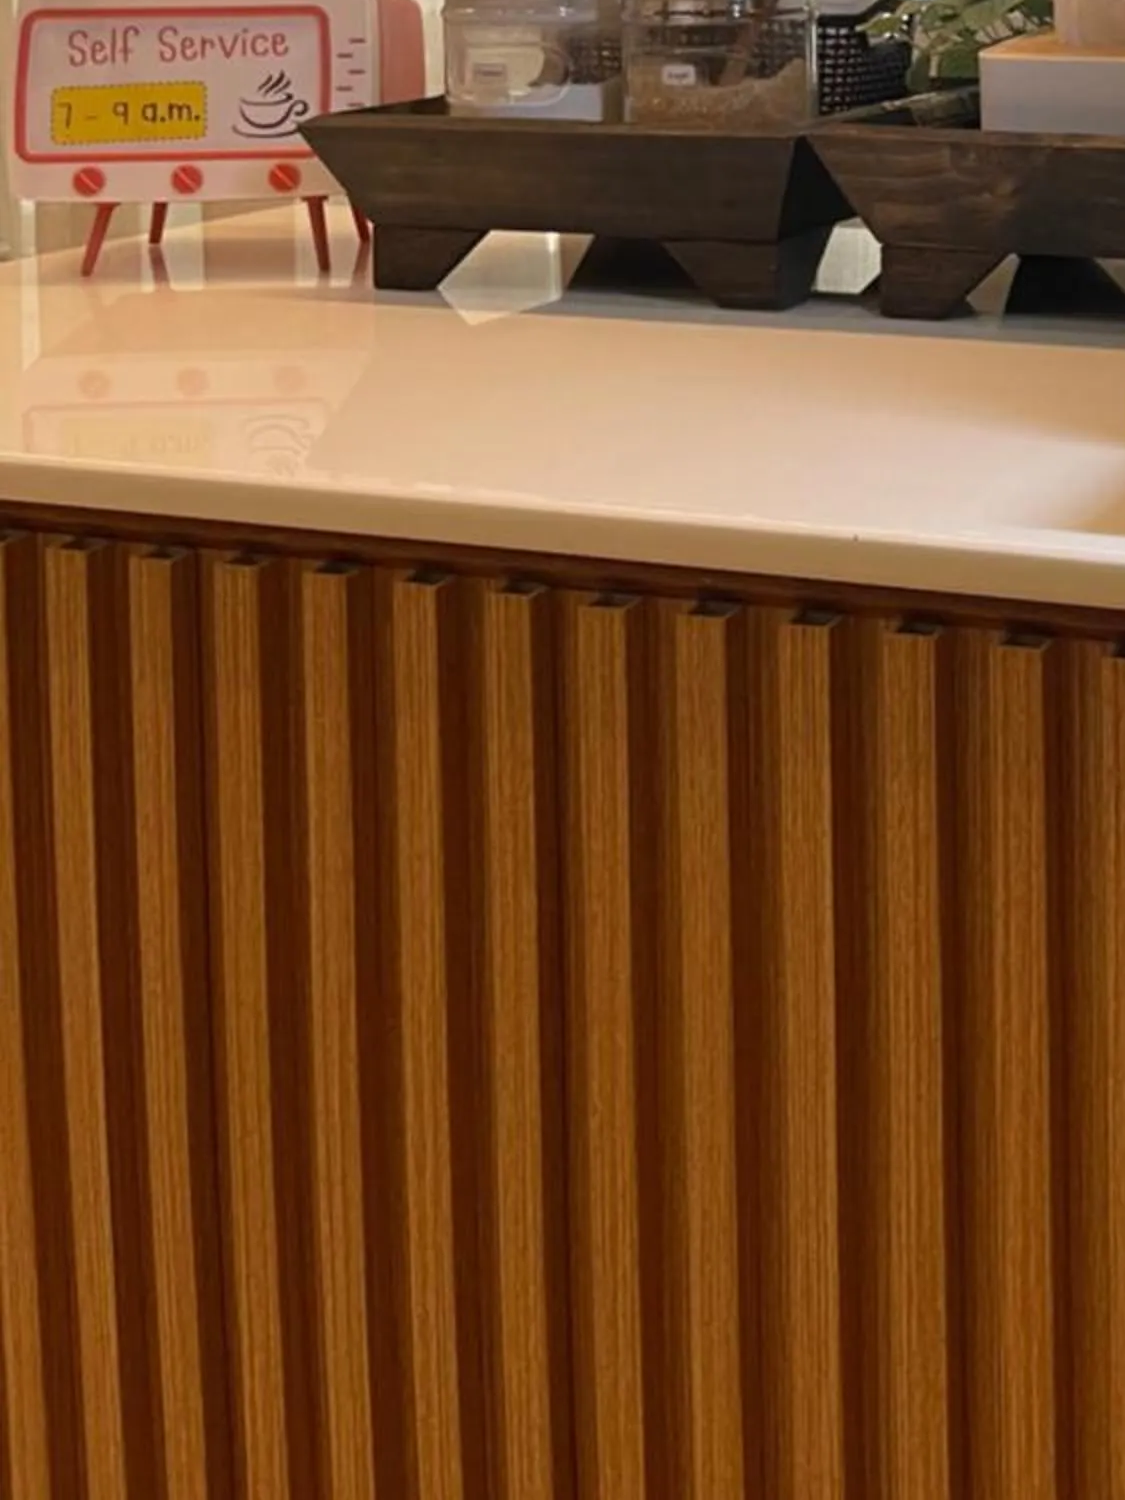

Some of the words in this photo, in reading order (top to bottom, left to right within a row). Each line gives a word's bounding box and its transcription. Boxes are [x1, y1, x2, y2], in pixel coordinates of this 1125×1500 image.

[67, 26, 140, 67] Self
[158, 26, 290, 63] Service
[58, 102, 73, 129] 7
[112, 103, 129, 125] 9
[141, 100, 201, 124] a.m.
